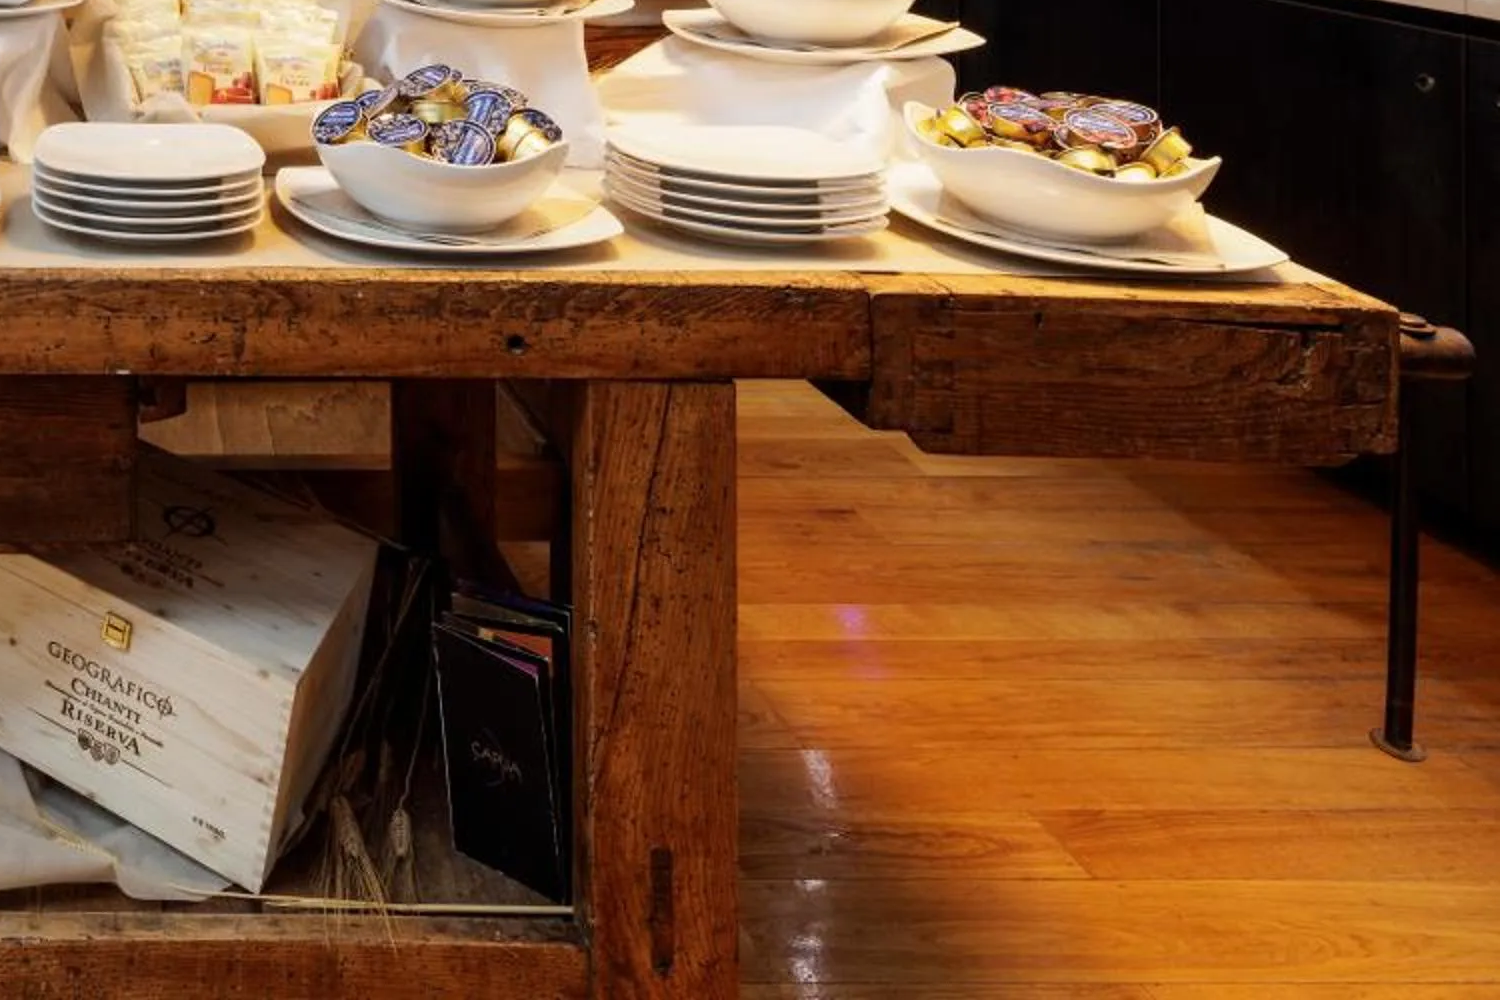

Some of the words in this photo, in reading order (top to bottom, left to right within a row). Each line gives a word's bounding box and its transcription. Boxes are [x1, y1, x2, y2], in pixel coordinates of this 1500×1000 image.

[47, 640, 176, 719] GEOGRAFICO
[70, 677, 142, 726] CHIANTI
[60, 699, 141, 757] RISERVA
